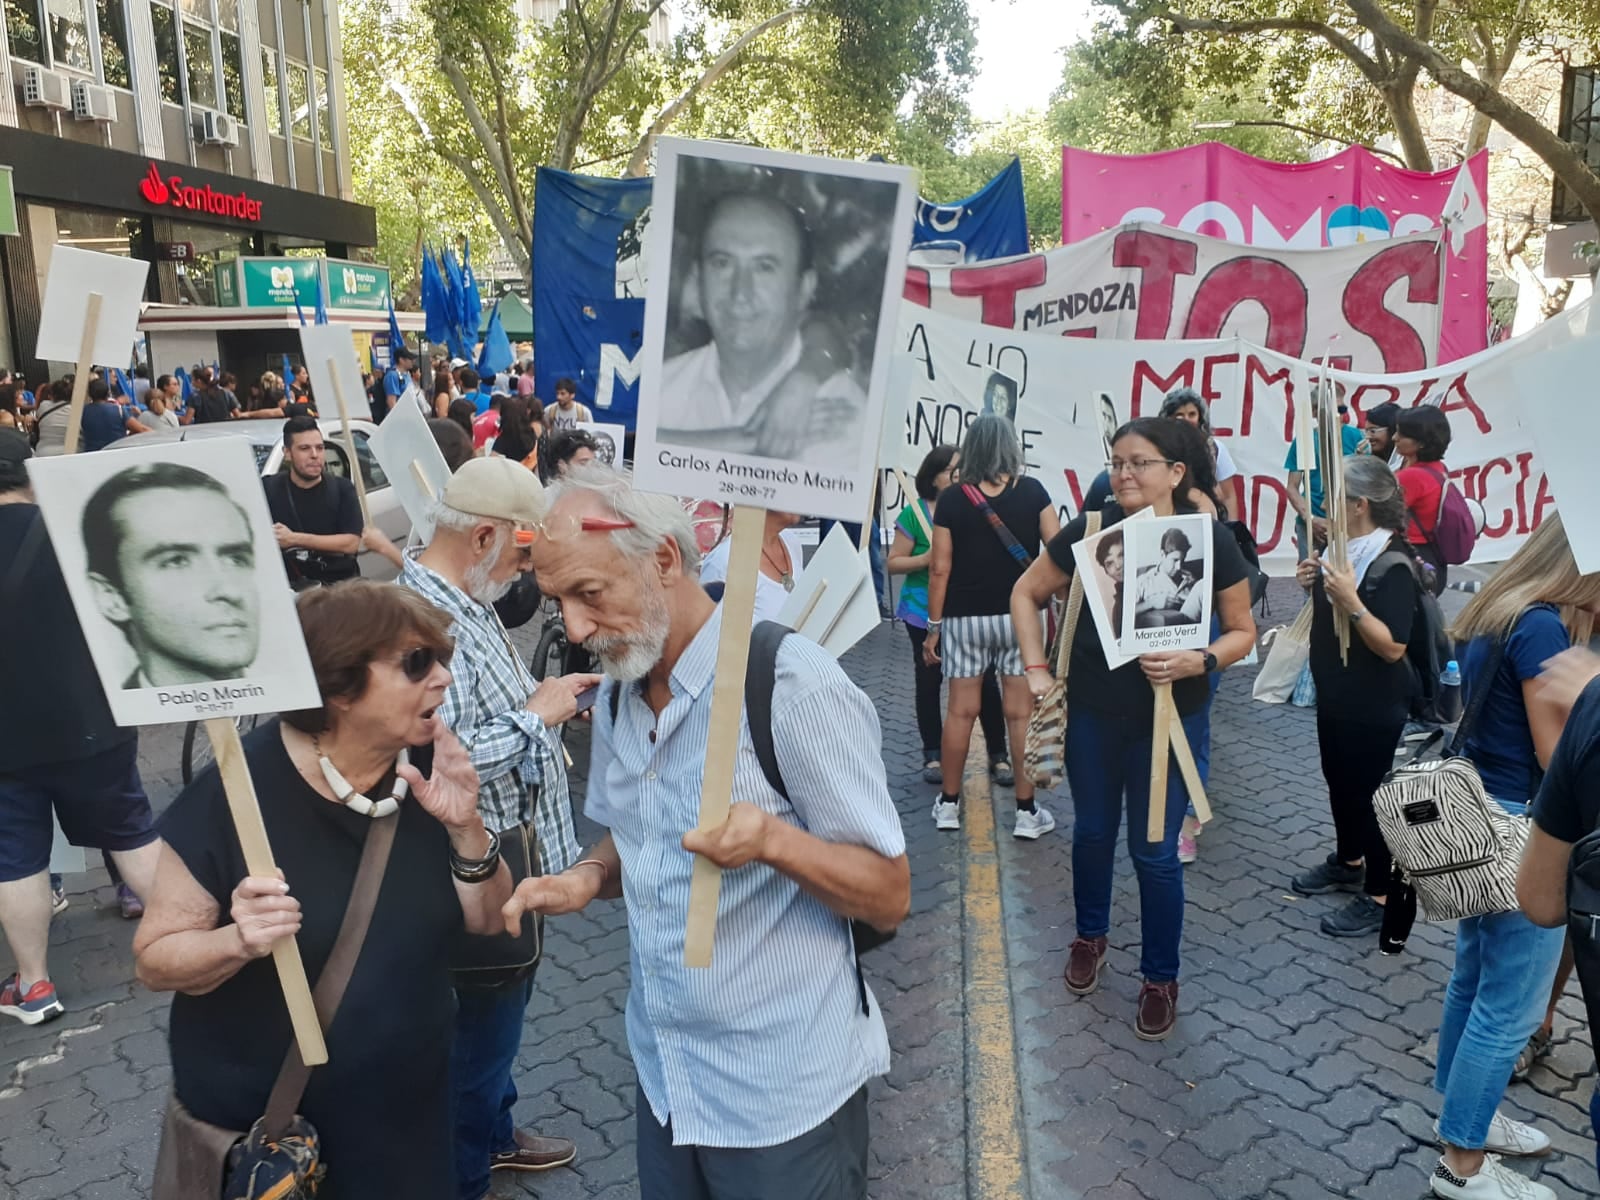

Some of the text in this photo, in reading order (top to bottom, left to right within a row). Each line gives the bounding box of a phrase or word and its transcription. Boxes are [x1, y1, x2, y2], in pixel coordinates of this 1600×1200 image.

[169, 175, 263, 221] Santander
[1022, 282, 1137, 332] MENDOZA
[1130, 352, 1493, 444] MEMRIA
[905, 396, 979, 449] ÑO
[658, 450, 711, 472] Carlos
[715, 458, 799, 484] Armando
[718, 481, 776, 499] 28-08-77
[1135, 626, 1198, 640] Marcelo Verd
[158, 690, 209, 705] Pablo
